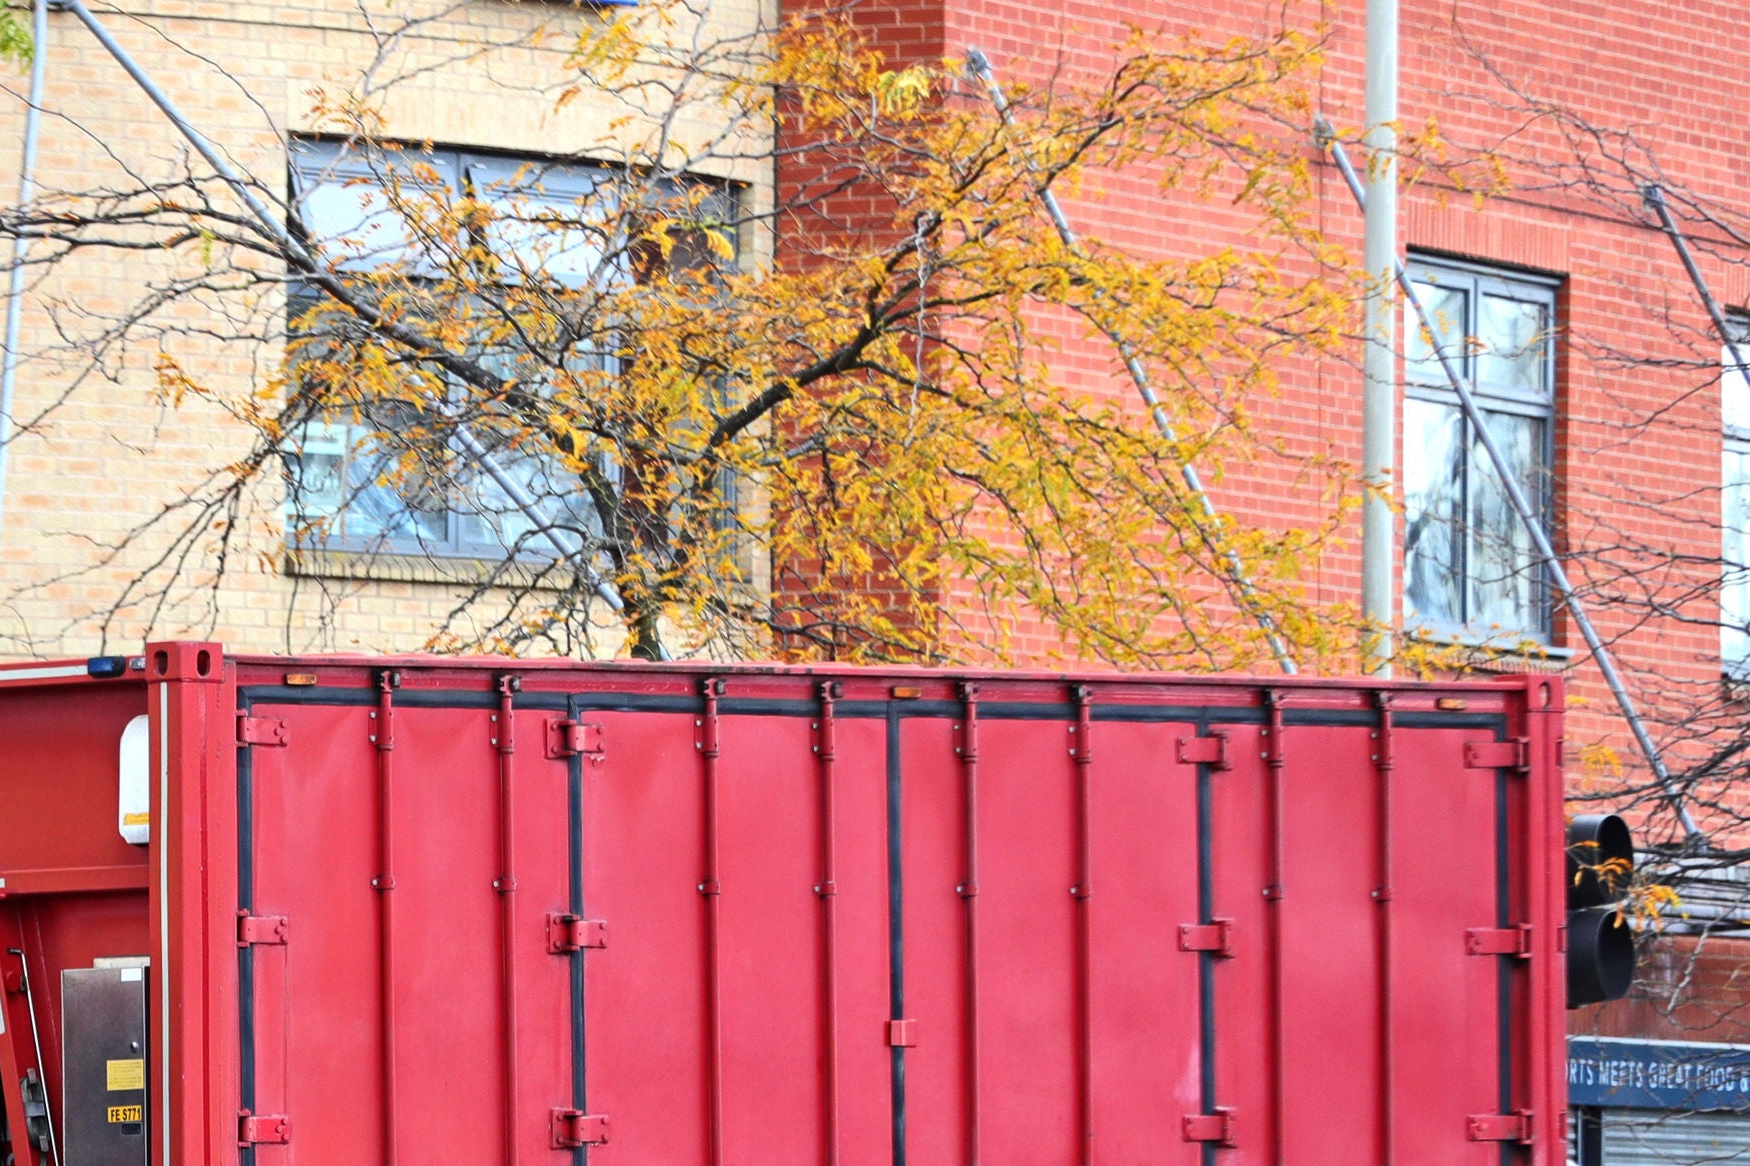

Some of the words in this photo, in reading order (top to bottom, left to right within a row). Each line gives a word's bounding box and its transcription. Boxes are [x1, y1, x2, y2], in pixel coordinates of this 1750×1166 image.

[1600, 1060, 1643, 1088] MEETS
[1648, 1062, 1692, 1089] GREAT
[1696, 1064, 1736, 1091] FOOD
[110, 1109, 120, 1120] FE
